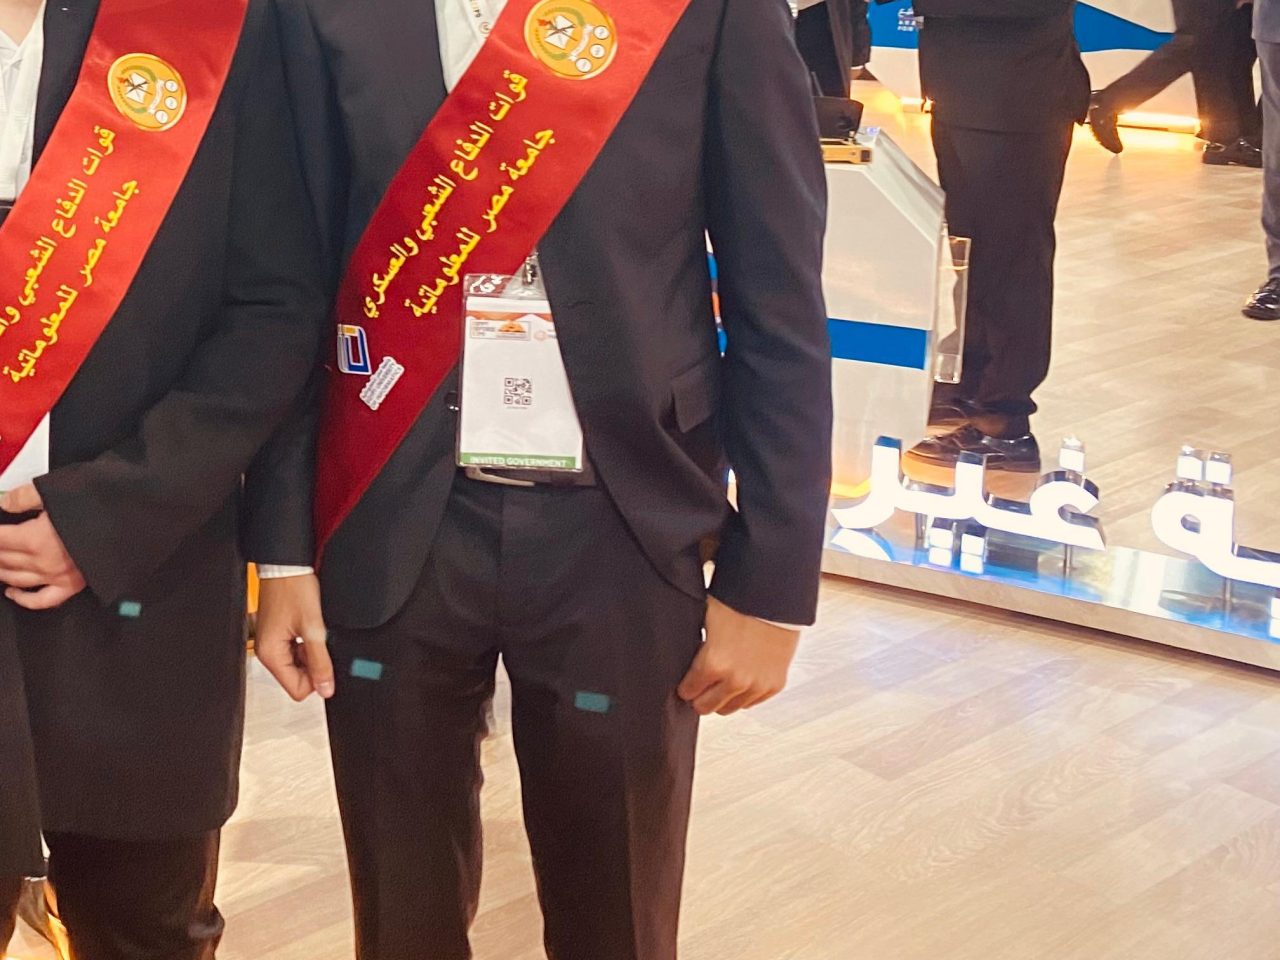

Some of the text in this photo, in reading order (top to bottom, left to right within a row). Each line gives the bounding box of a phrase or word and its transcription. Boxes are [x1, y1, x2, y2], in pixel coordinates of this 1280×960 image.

[489, 69, 528, 121] قوات
[82, 125, 116, 176] قوات
[449, 120, 494, 181] الدفاع
[51, 178, 88, 239] الدفاع
[404, 129, 556, 318] جامعة مصر للمعلوماتية
[416, 174, 456, 241] الشعبي
[2, 180, 140, 383] جامعة مصر للمعلوماتية
[18, 236, 58, 306] الشعبي
[363, 236, 419, 318] والعسكري
[470, 456, 567, 468] INVITED GOVERNMENT
[831, 435, 1107, 567] غير
